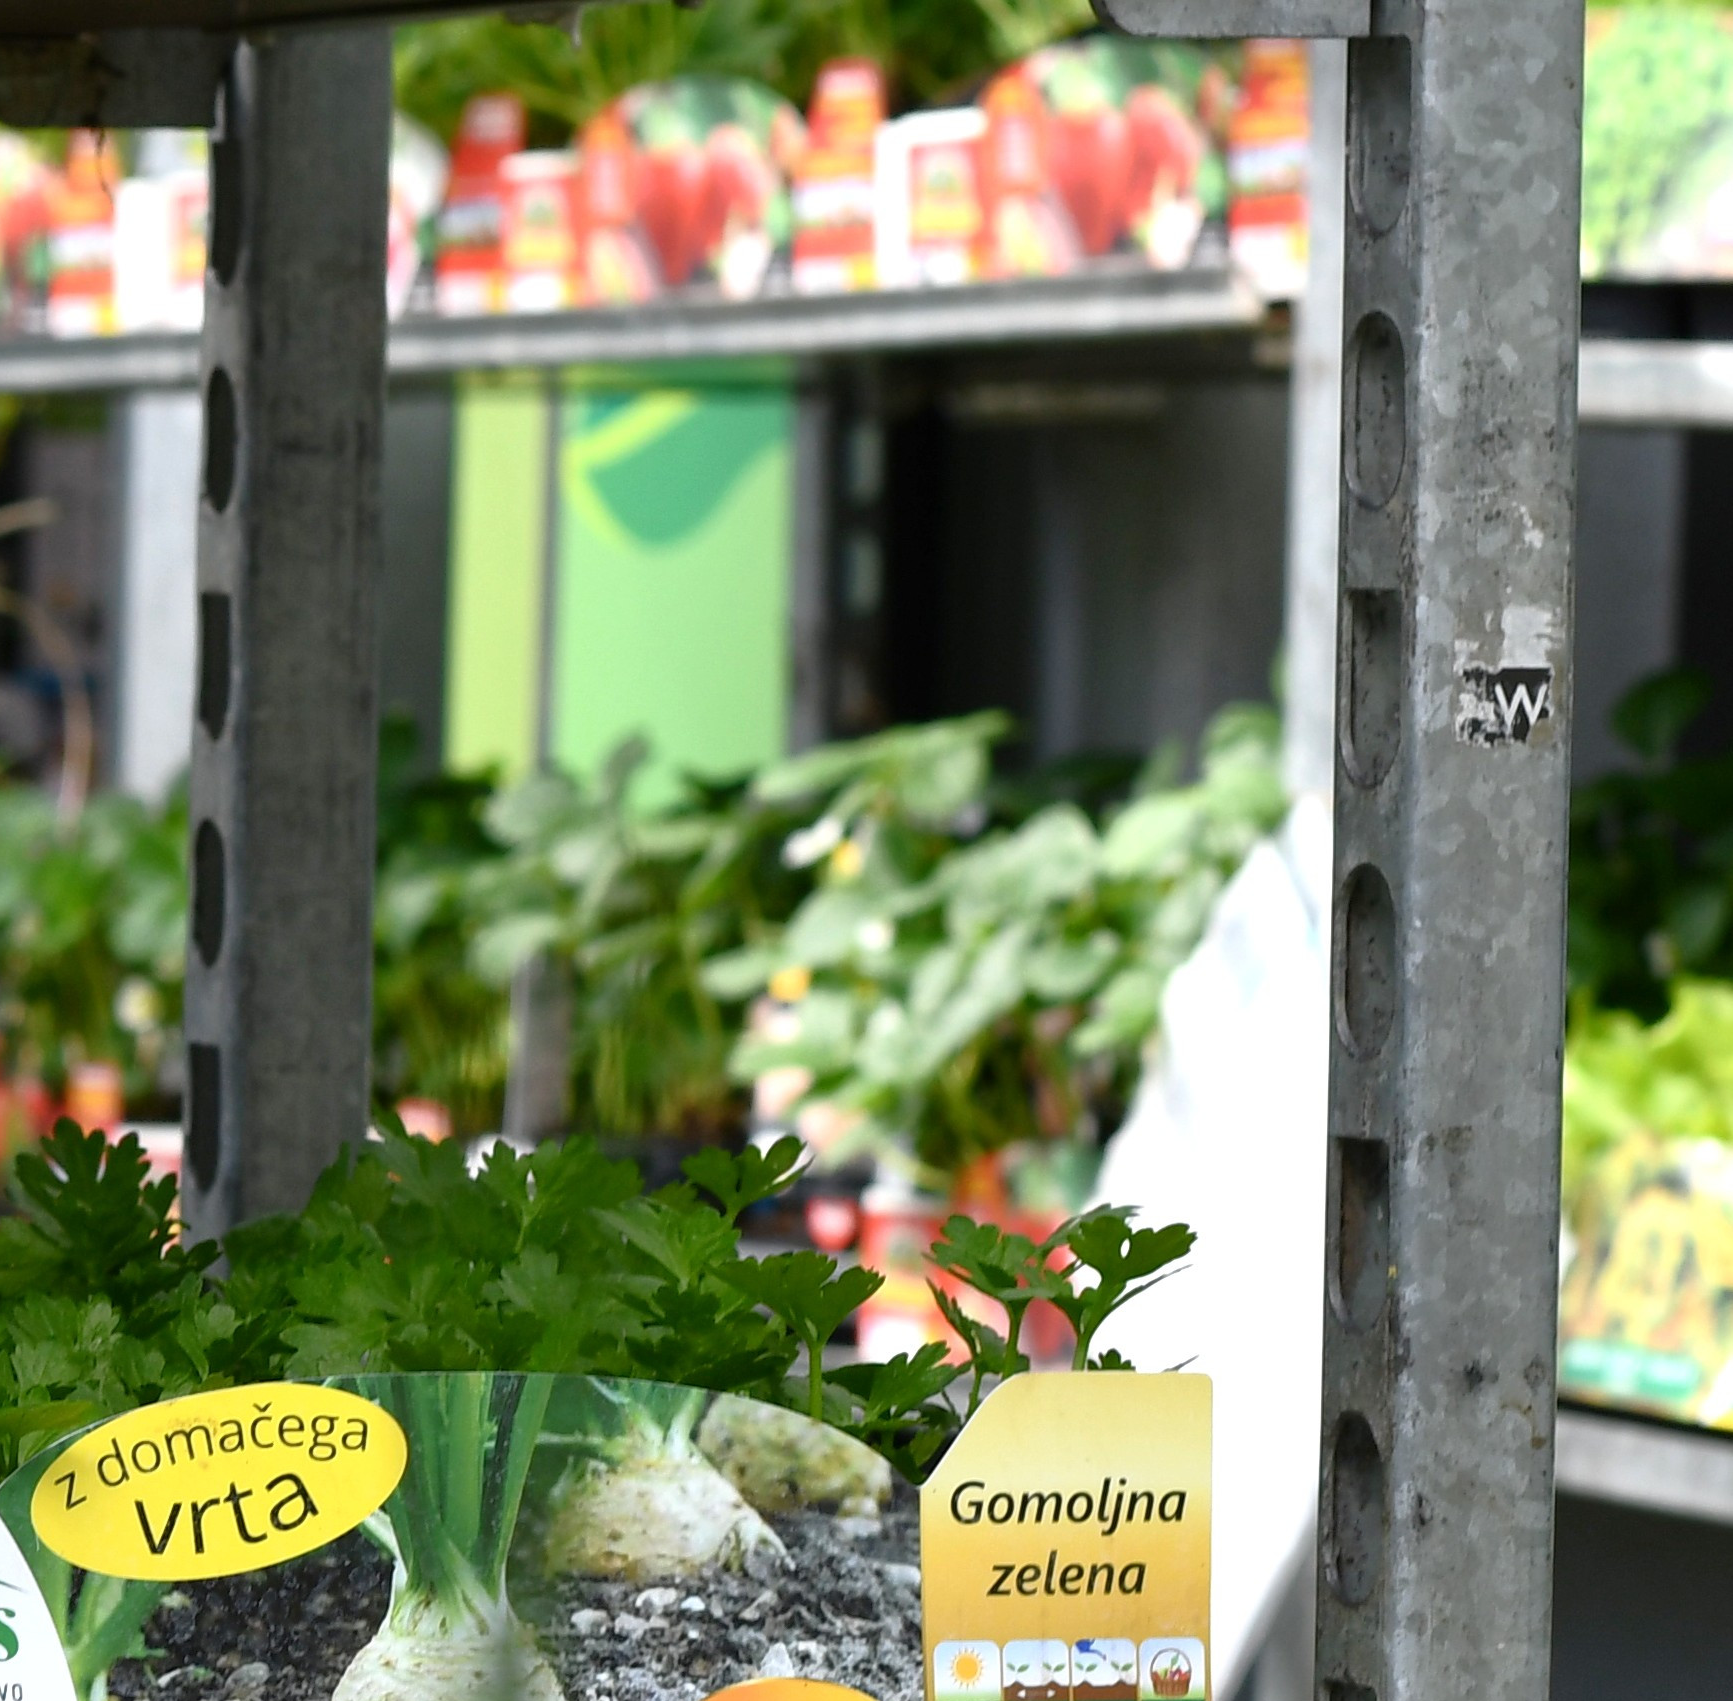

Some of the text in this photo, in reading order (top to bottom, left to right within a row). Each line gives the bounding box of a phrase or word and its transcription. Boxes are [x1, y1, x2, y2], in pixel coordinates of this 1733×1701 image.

[54, 1401, 369, 1511] z domačega
[135, 1472, 319, 1555] vrta
[950, 1477, 1188, 1536] Gomoljna
[987, 1549, 1147, 1597] zelena
